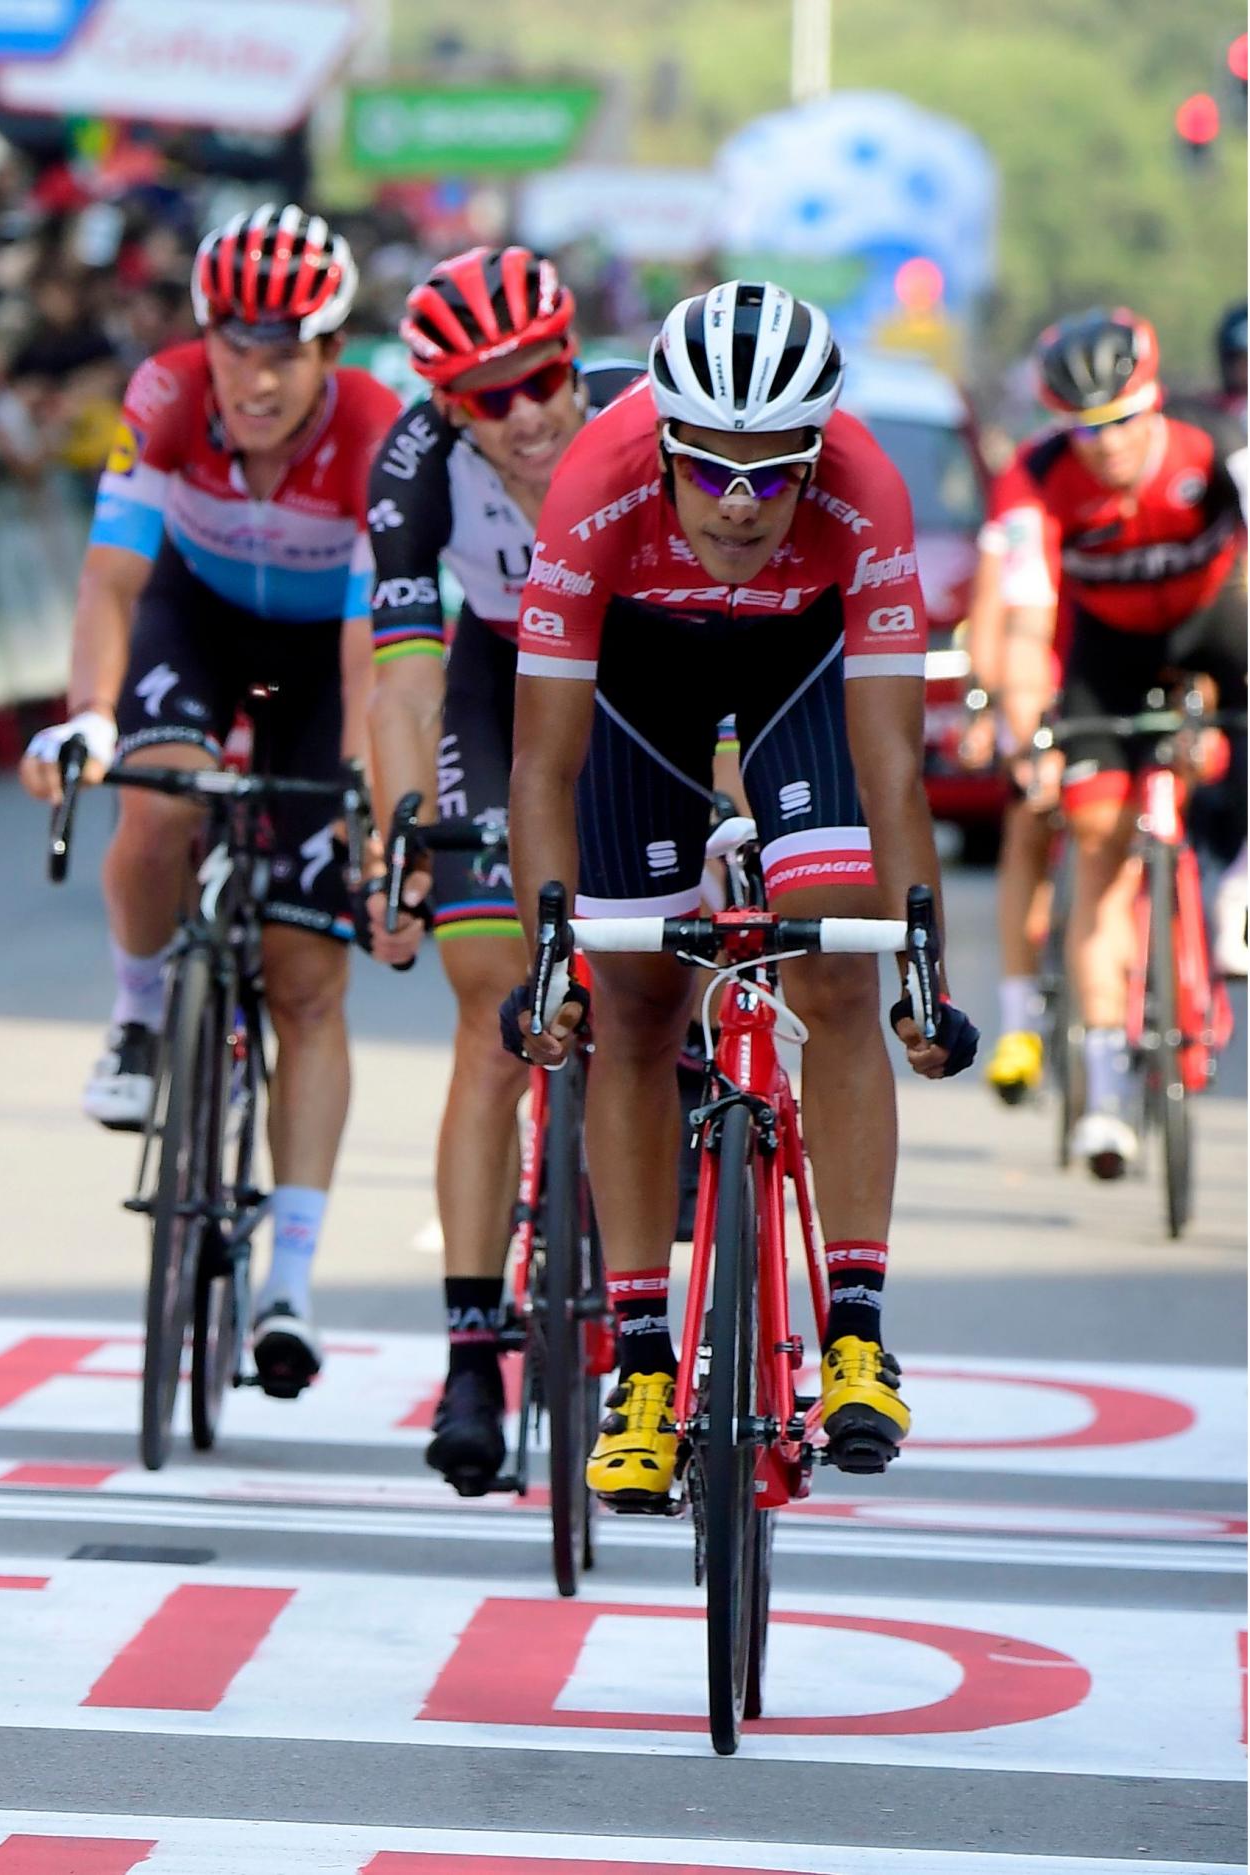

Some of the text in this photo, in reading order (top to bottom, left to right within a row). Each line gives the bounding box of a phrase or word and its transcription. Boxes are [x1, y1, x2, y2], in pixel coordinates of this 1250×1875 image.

[381, 413, 439, 480] UAE
[568, 479, 661, 542] TREK
[522, 606, 565, 638] ca
[867, 604, 915, 633] ca
[436, 733, 468, 819] UAE
